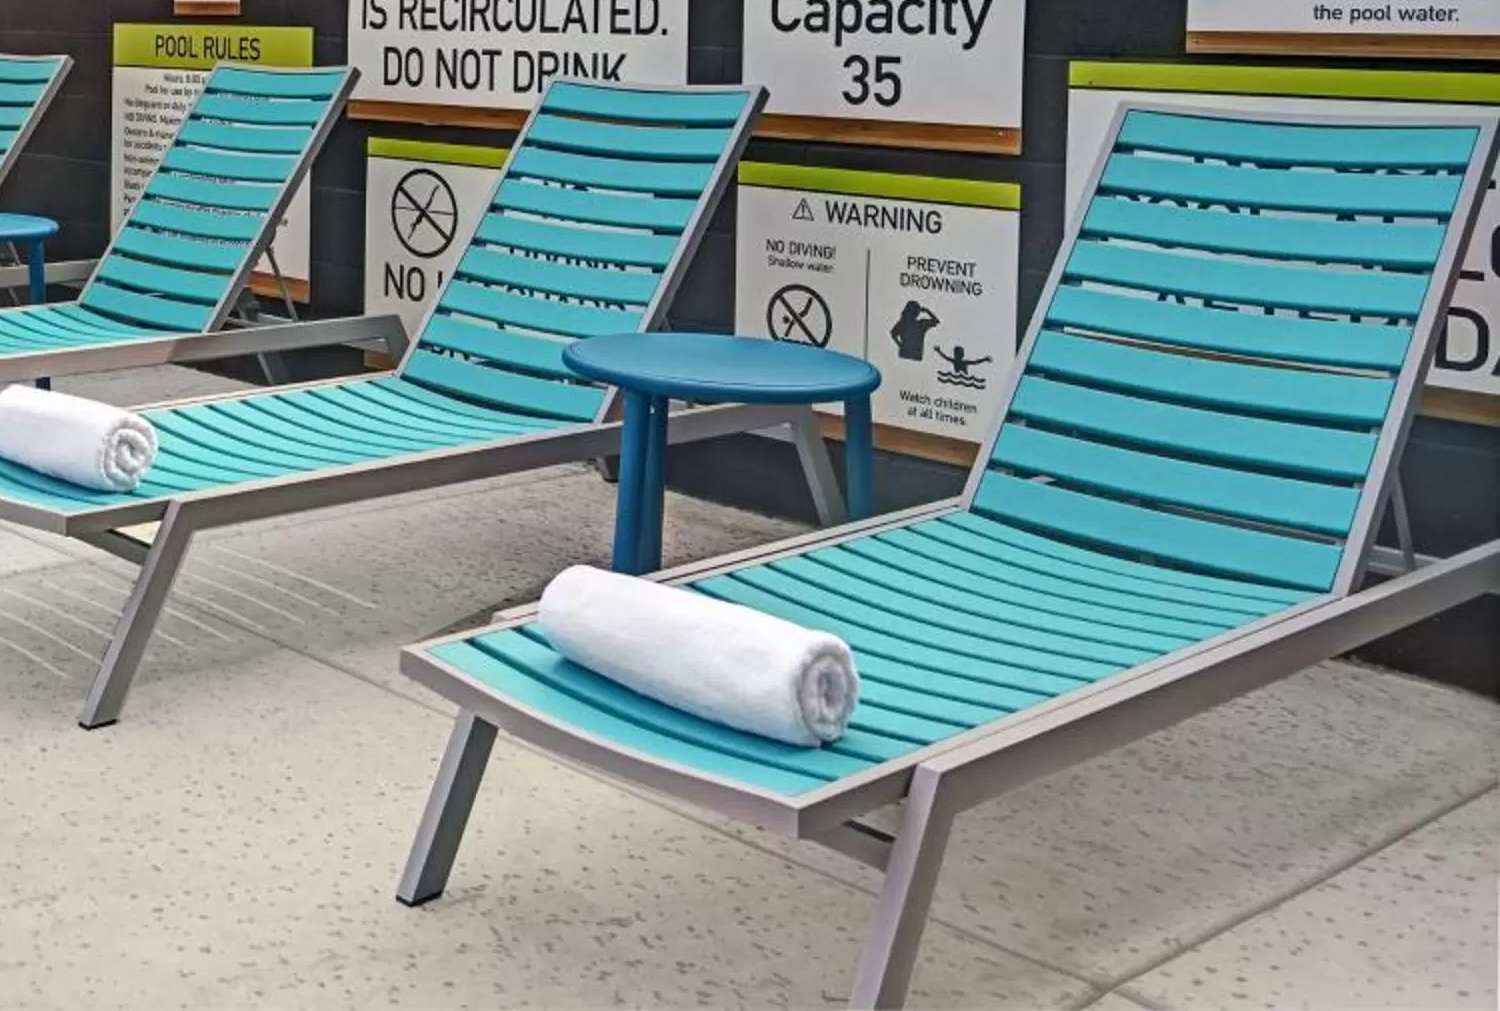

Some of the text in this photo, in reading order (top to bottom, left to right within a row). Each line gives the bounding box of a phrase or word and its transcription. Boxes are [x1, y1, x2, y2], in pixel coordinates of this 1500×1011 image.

[1313, 5, 1459, 25] the pool water.
[155, 34, 261, 61] POOL RULES
[384, 47, 423, 87] DO
[436, 48, 502, 90] NOT
[842, 55, 902, 106] 35
[825, 200, 942, 234] WARNING
[766, 239, 784, 253] NO
[768, 255, 804, 269] Shallow
[907, 256, 977, 278] PREVENT
[384, 262, 425, 302] NO
[900, 273, 983, 297] DROWNING
[900, 389, 978, 414] Watch children
[907, 407, 917, 416] at
[919, 408, 933, 420] all
